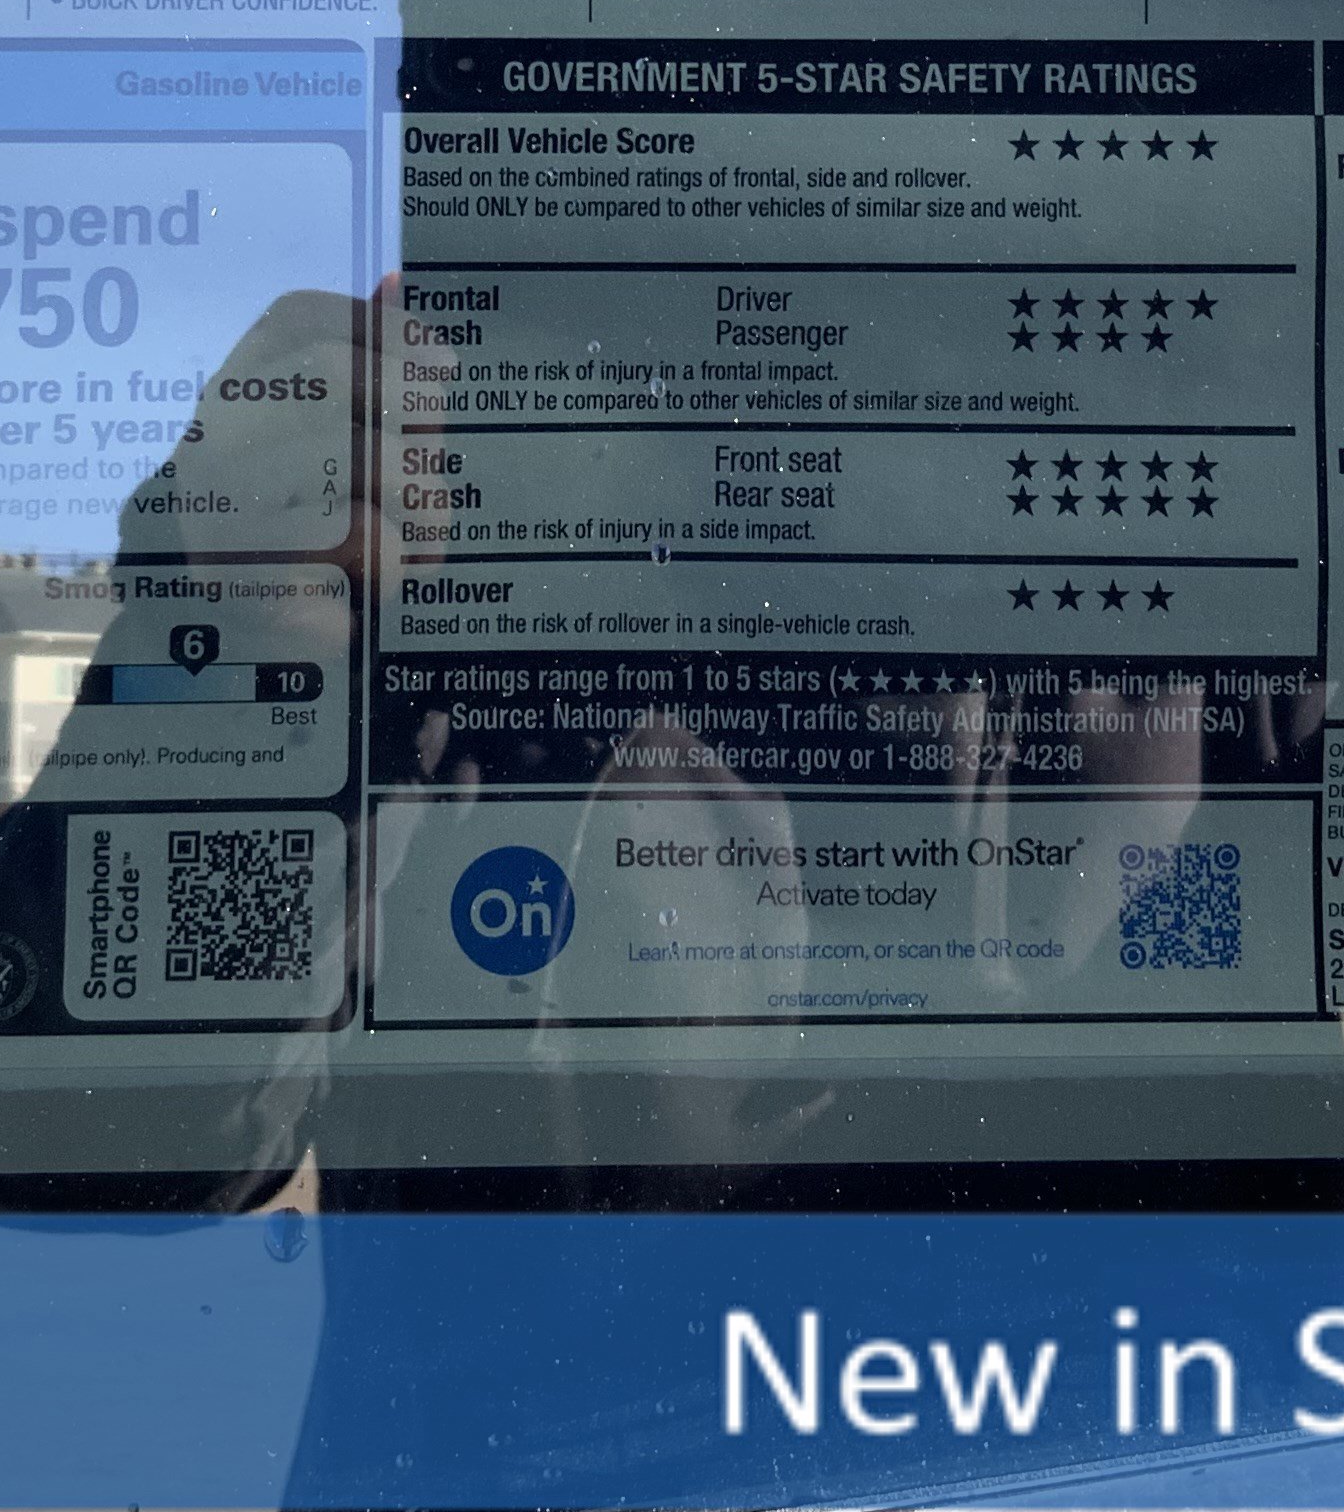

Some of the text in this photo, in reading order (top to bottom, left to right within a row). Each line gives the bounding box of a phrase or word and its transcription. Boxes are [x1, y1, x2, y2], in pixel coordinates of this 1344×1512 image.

[116, 71, 362, 96] Gasoline Vehicle
[504, 58, 1196, 93] GOVERNMENT 5-STAR SAFETY RATINGS
[405, 127, 694, 154] Overall Vehicle Score
[404, 166, 970, 192] Based on the combined ratings of frontal, side and rollover.
[404, 286, 499, 311] Frontal
[718, 286, 792, 312] Driver
[404, 320, 481, 345] Crash
[717, 320, 848, 352] Passenger
[403, 449, 462, 475] Side
[716, 446, 841, 473] Front seat
[402, 483, 481, 511] Crash
[715, 481, 834, 508] Rear seat
[402, 579, 513, 604] Rollover
[184, 630, 204, 659] 6
[278, 671, 305, 692] 10
[272, 707, 316, 726] Best
[615, 837, 709, 868] Better
[716, 837, 805, 868] drives
[815, 842, 884, 867] start
[892, 838, 958, 866] with
[84, 829, 110, 1000] Smartphone
[470, 889, 554, 941] On
[113, 957, 138, 1000] QR
